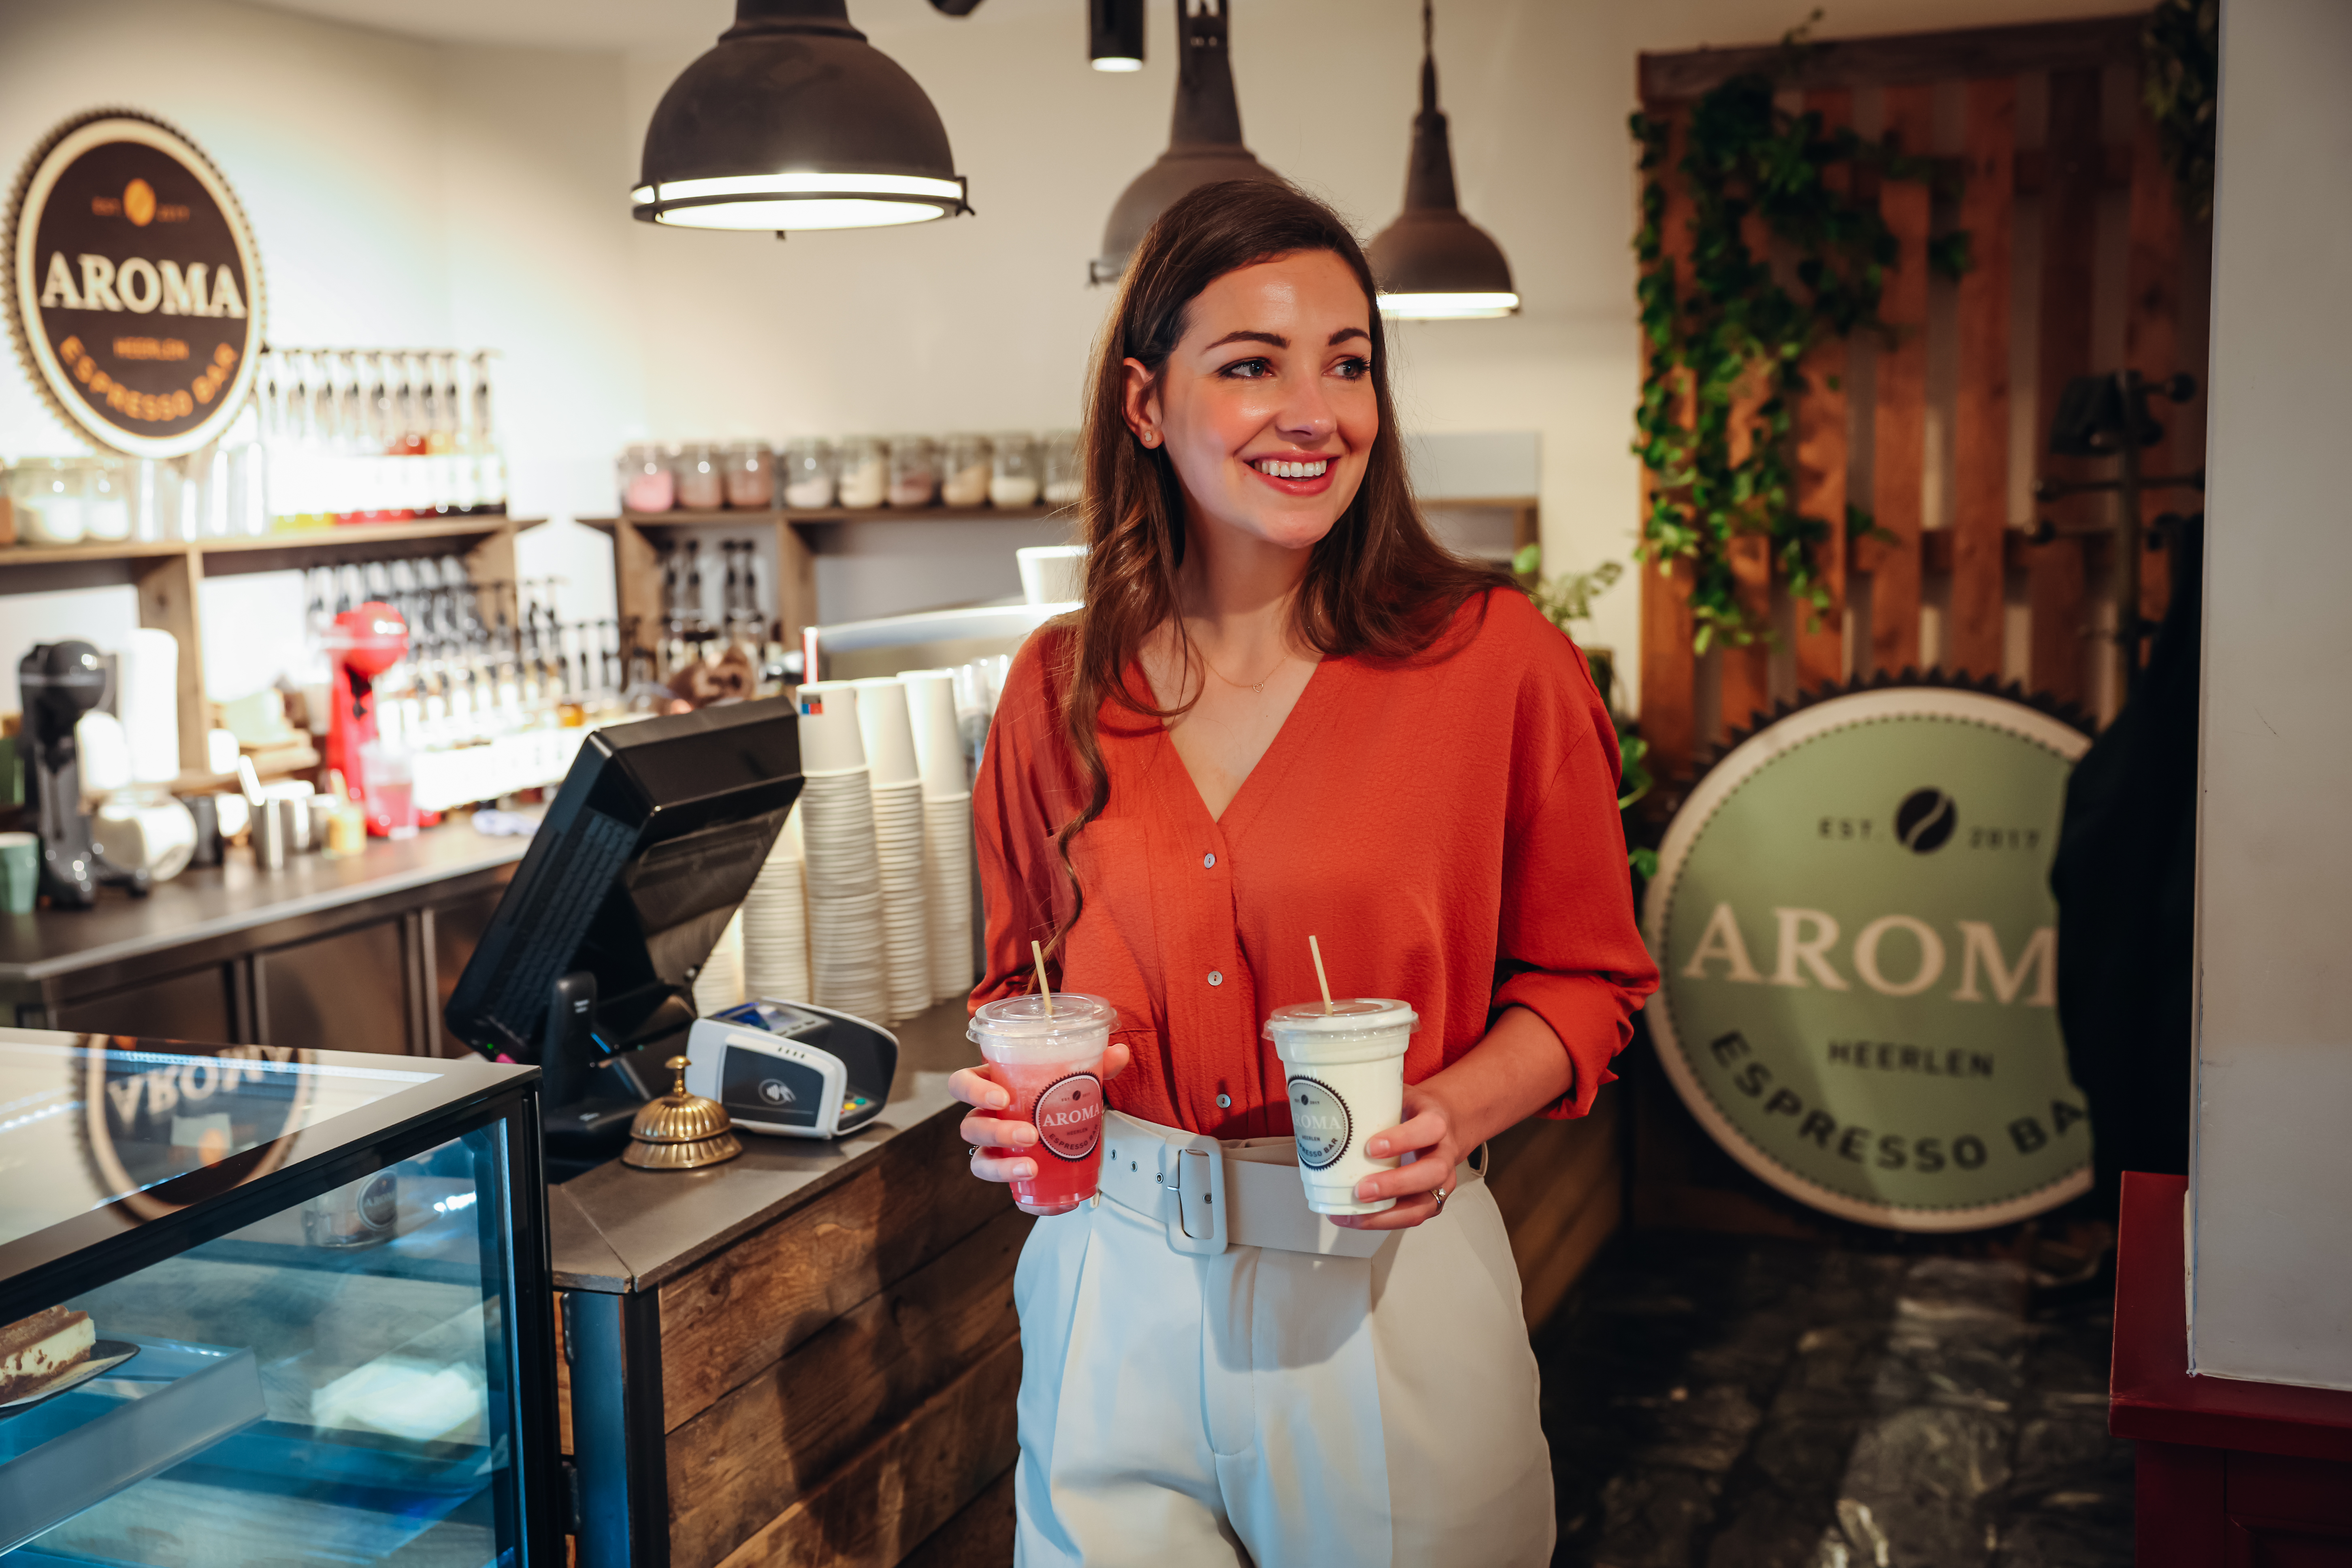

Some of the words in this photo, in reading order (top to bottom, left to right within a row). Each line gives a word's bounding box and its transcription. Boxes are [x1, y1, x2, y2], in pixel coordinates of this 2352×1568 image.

[40, 251, 247, 318] AROMA
[1682, 902, 2058, 1007] AROM
[1827, 1040, 1994, 1079] HEERLEN
[1709, 1030, 1988, 1173] ESPRESSO
[2007, 1099, 2086, 1155] BA
[1042, 1103, 1100, 1127] AROMA
[1293, 1114, 1341, 1129] ROMA
[1049, 1133, 1089, 1150] ESPRESSO
[1067, 1127, 1088, 1136] HEERLEN
[1323, 1138, 1338, 1153] BAR
